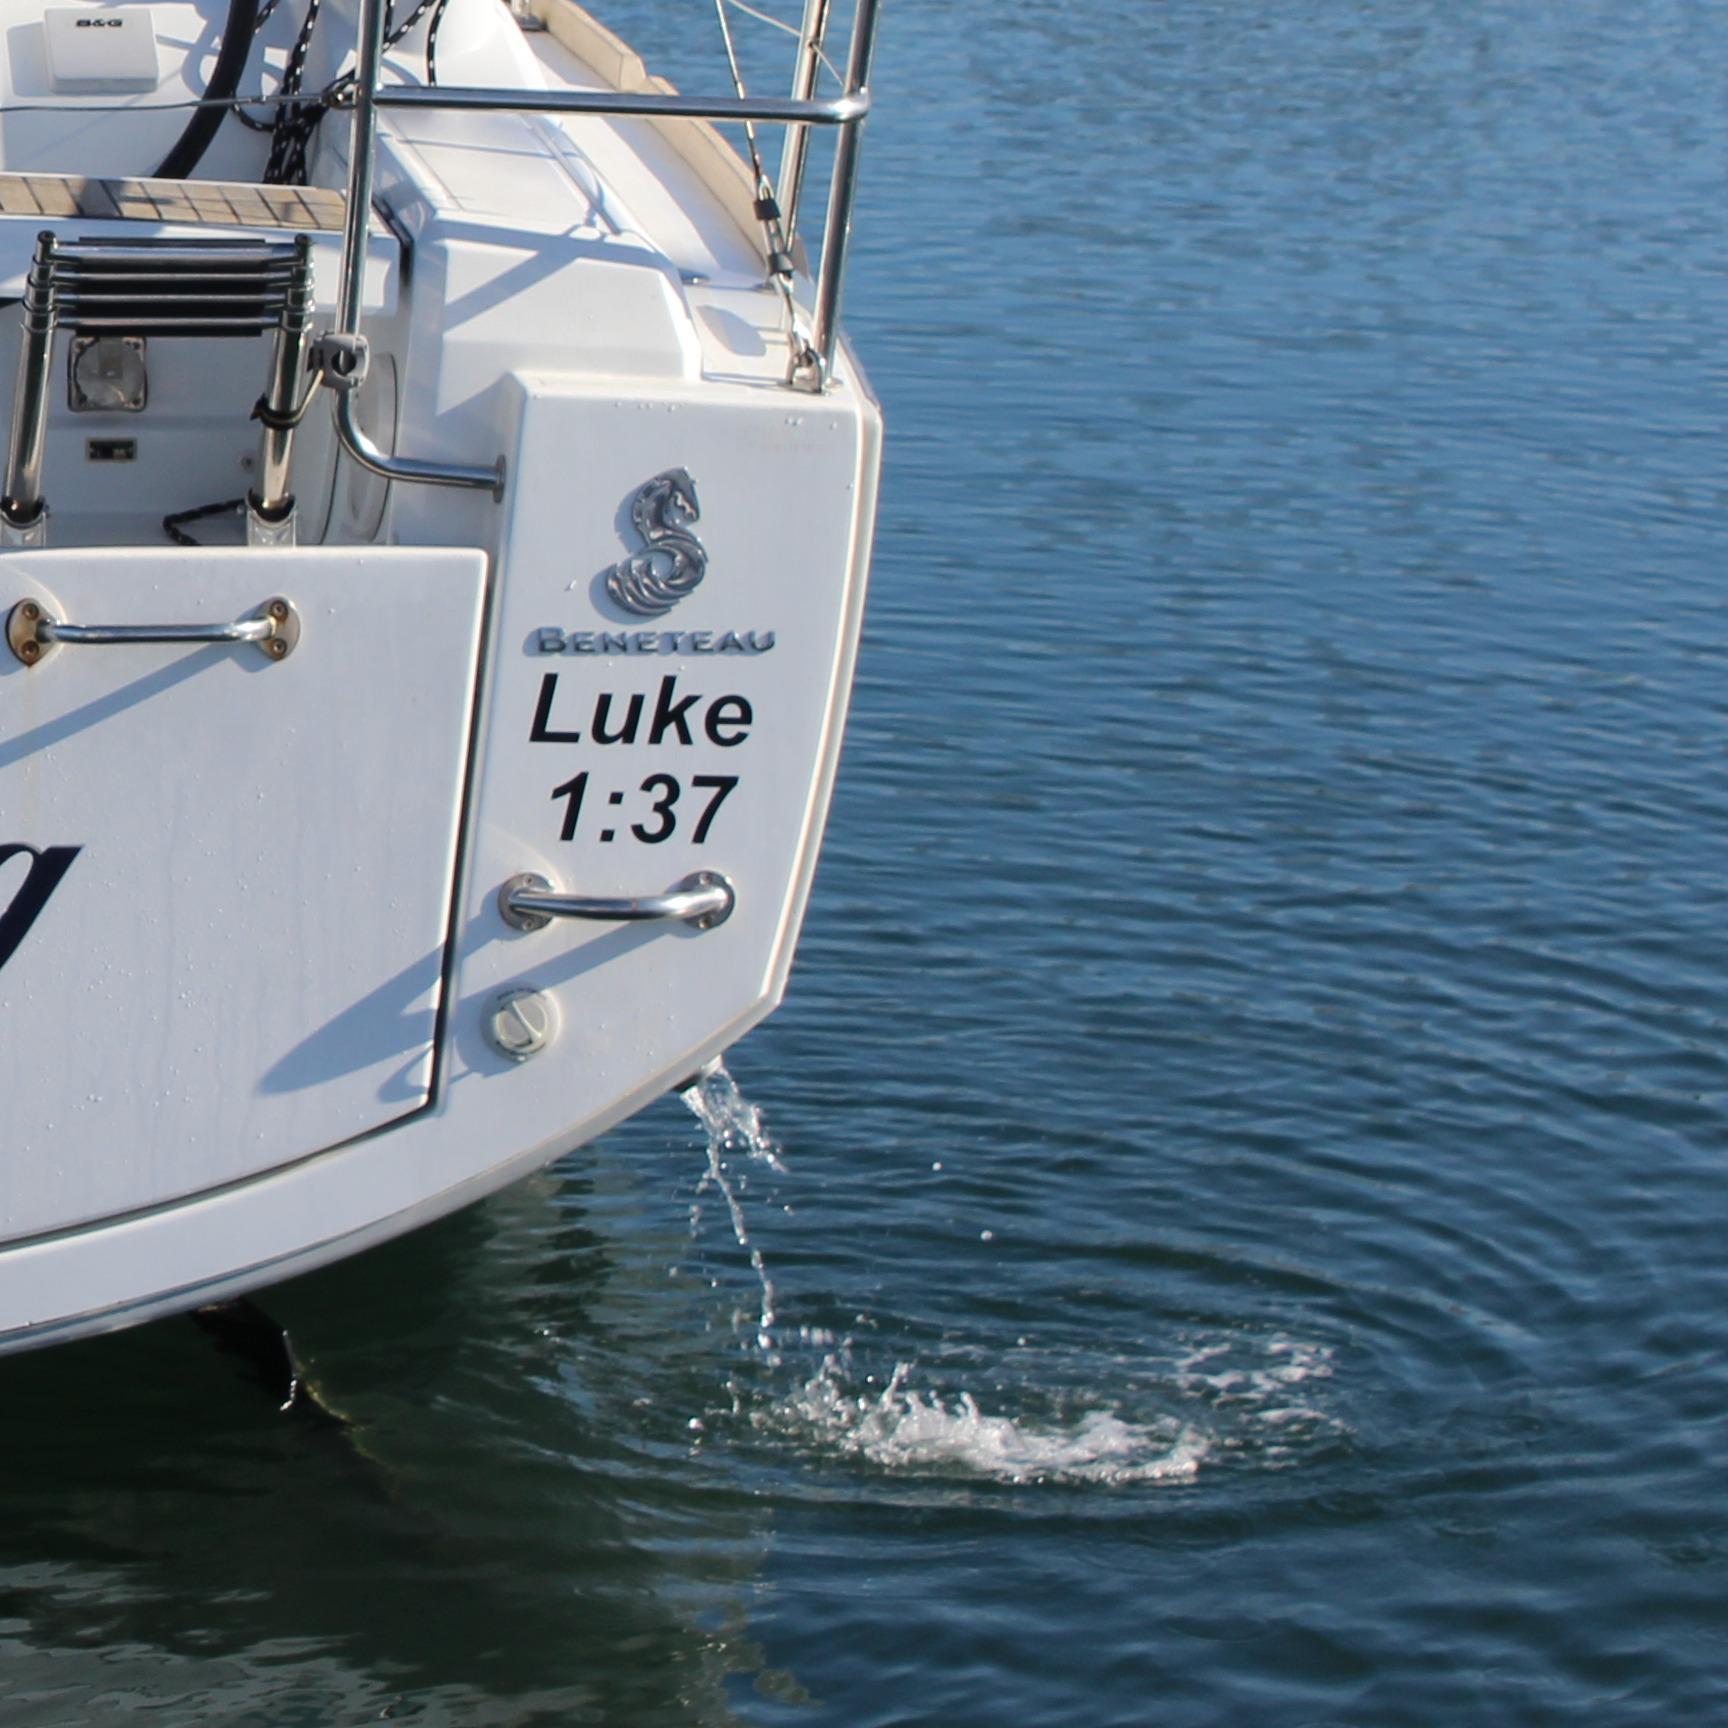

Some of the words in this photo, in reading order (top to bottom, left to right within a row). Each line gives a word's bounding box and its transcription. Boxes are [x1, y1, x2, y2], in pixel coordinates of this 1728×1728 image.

[537, 627, 776, 654] BENETEAU
[529, 672, 753, 747] Luke
[551, 771, 740, 844] 1:37
